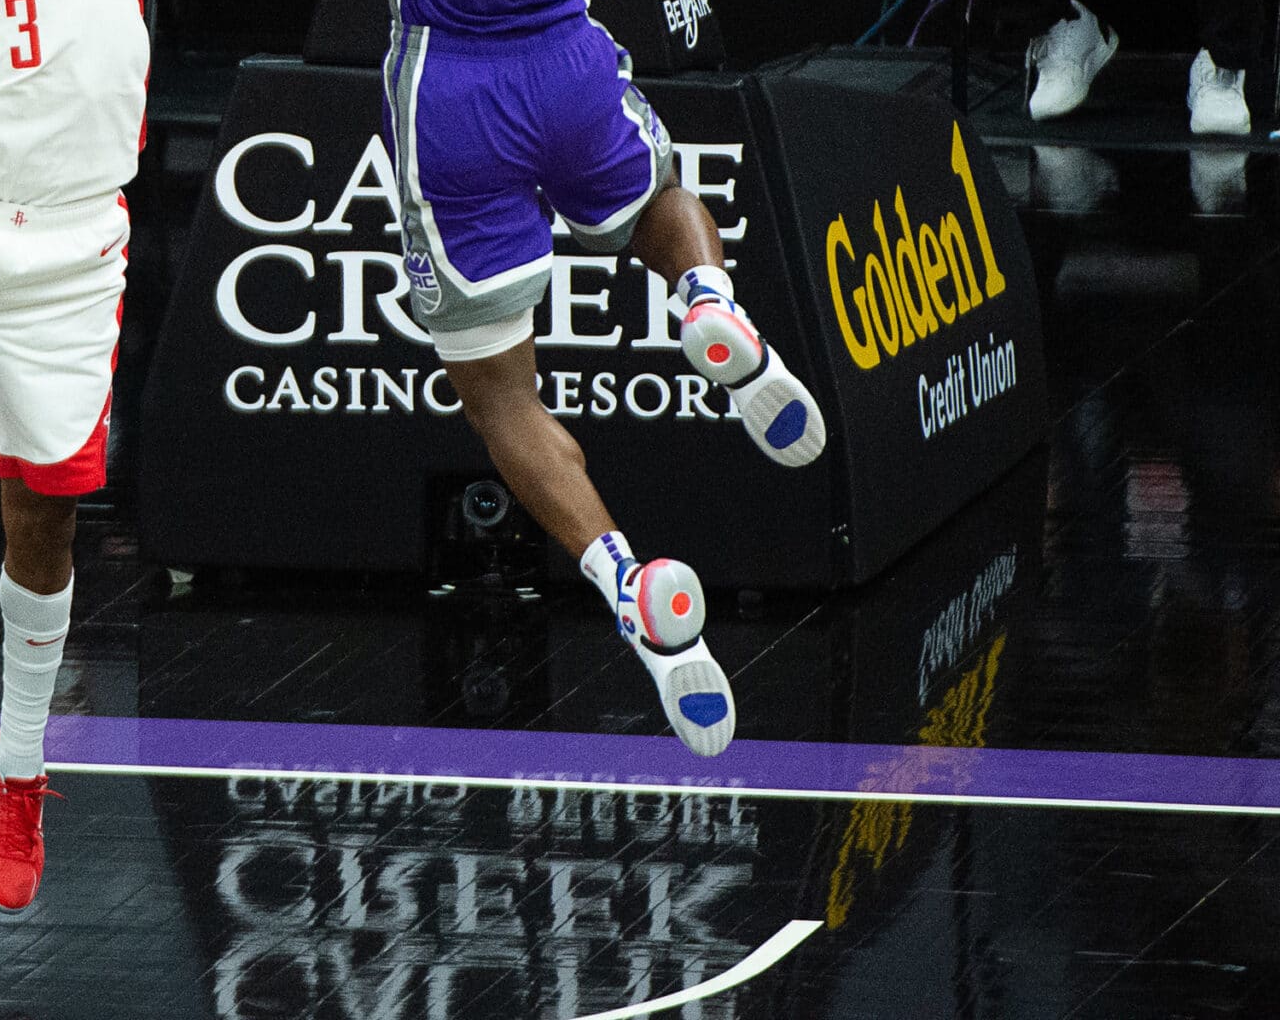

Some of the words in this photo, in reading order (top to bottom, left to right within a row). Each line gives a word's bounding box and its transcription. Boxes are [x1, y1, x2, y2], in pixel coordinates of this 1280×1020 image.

[826, 212, 983, 370] Golden
[951, 119, 1007, 300] 1
[918, 354, 967, 441] Credit
[968, 332, 1017, 408] Union
